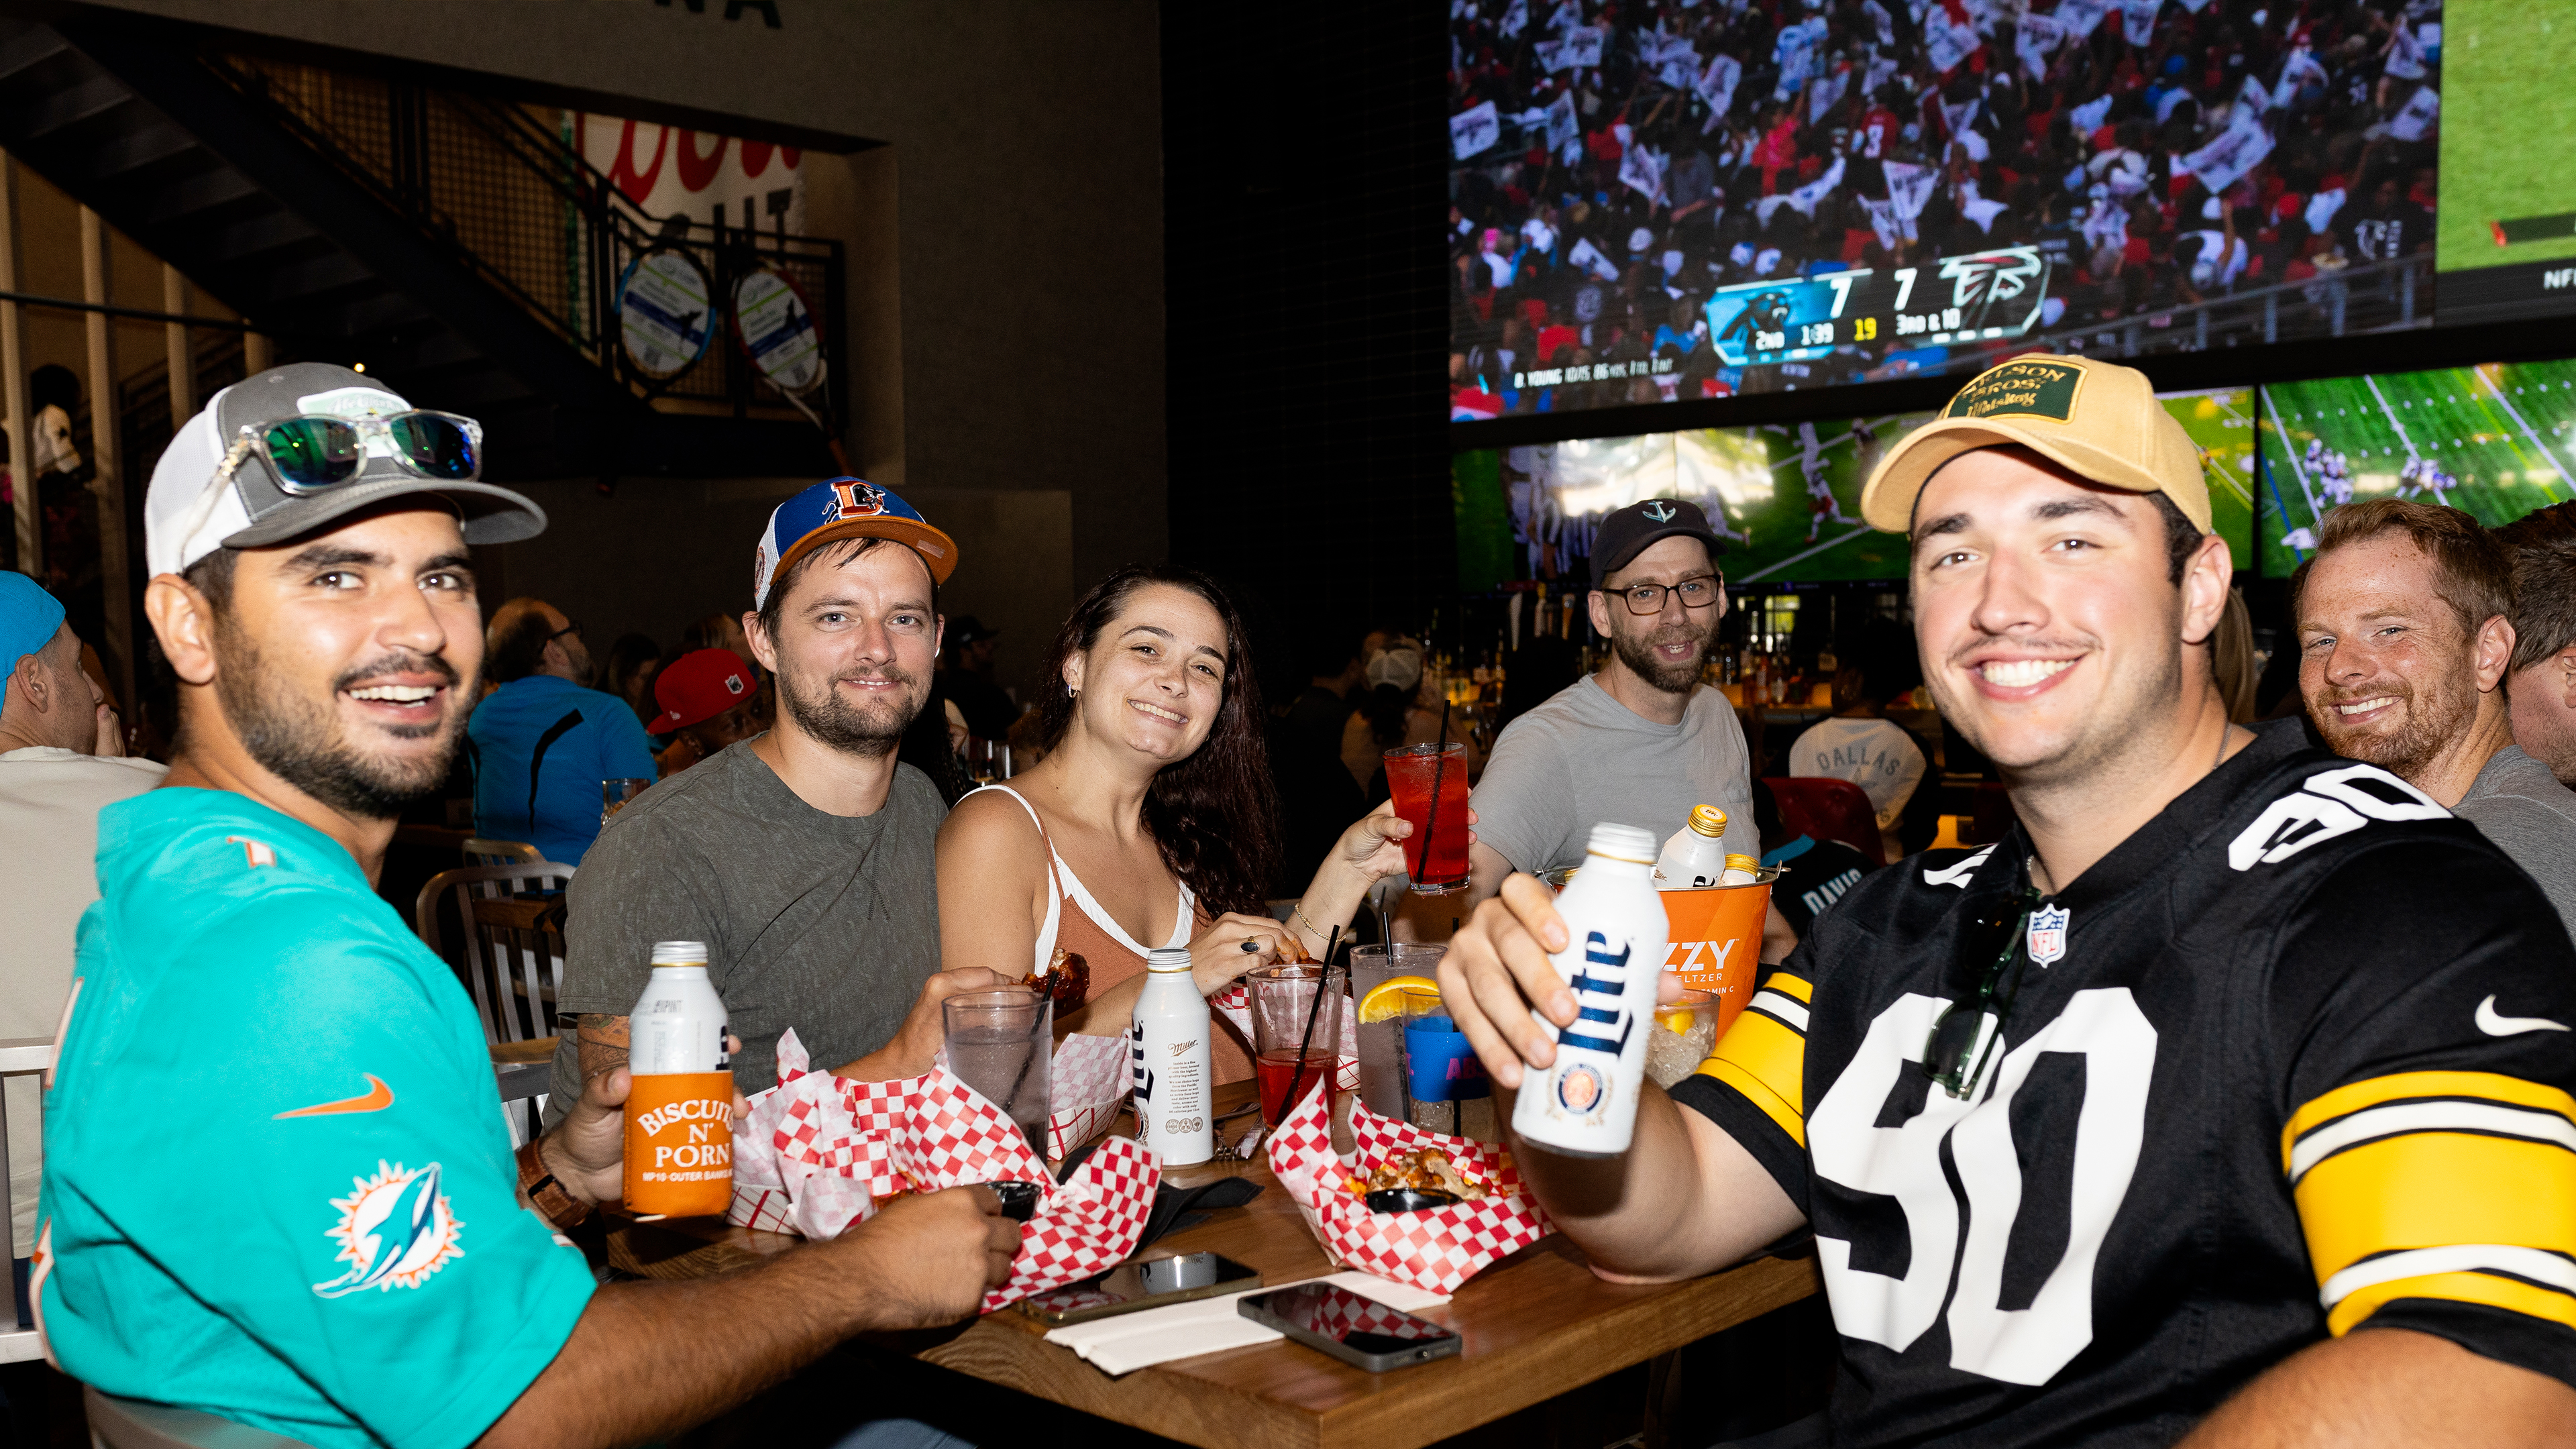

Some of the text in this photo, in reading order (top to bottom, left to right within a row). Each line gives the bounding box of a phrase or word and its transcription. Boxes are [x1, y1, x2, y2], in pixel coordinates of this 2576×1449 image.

[2544, 268, 2576, 283] NF
[1830, 268, 1917, 319] 7 7
[1854, 317, 1877, 341] 19
[1941, 307, 1960, 329] 10
[1817, 747, 1900, 775] DALLAS
[1662, 938, 1736, 971] ZZY
[2032, 932, 2057, 955] NFL
[1676, 973, 1723, 983] ELTZER
[1558, 930, 1633, 1060] Lite
[1168, 1039, 1198, 1055] Miller
[655, 1142, 730, 1168] PORN
[1805, 987, 2157, 1385] 90
